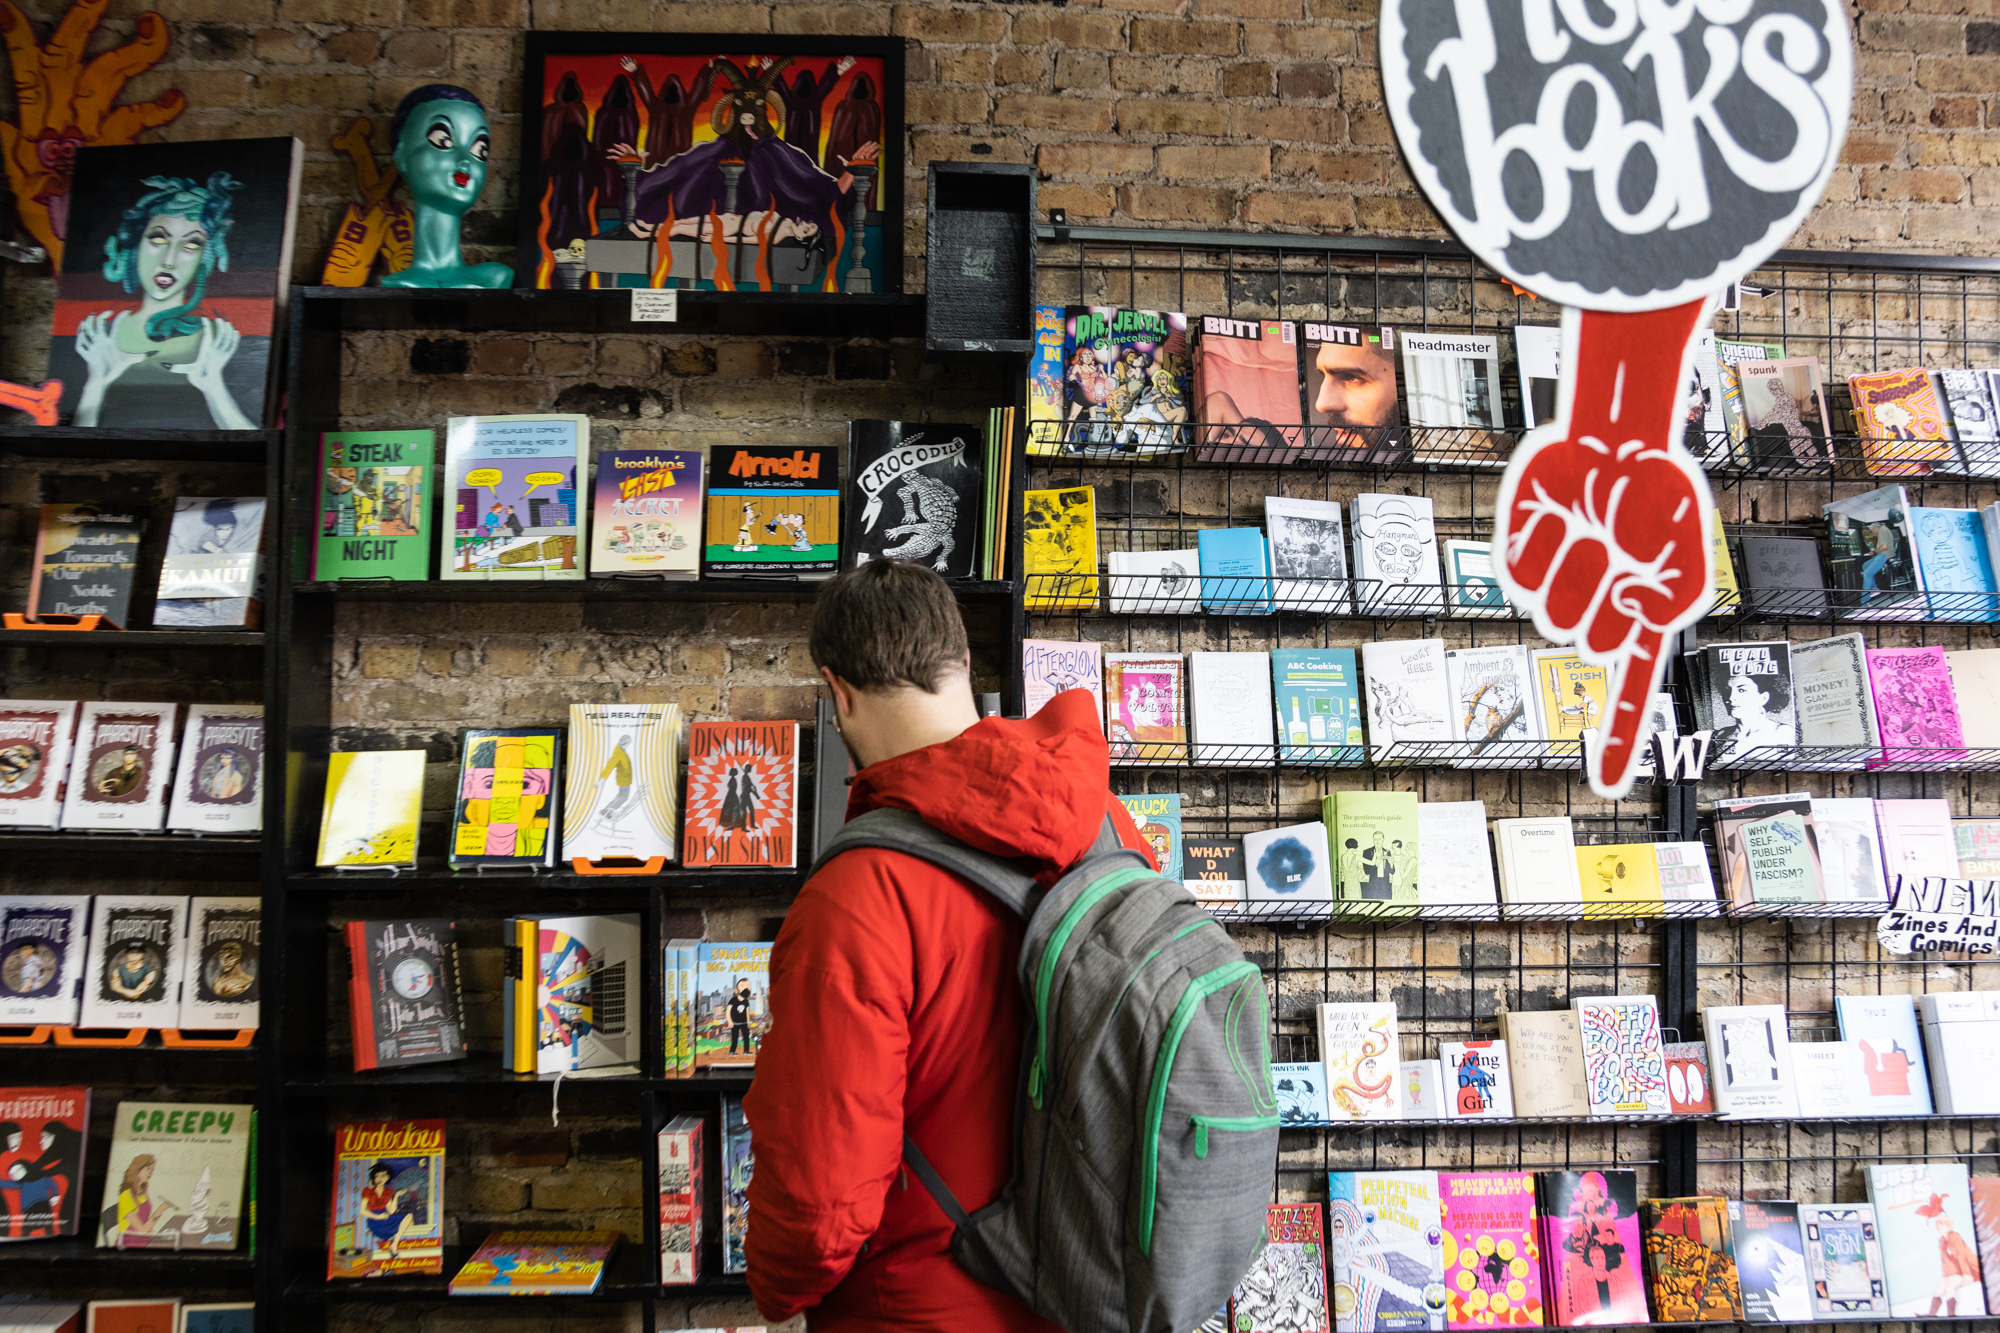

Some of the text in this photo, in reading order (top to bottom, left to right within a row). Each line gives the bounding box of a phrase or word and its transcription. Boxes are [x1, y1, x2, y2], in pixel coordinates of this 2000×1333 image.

[1425, 13, 1832, 249] books
[1043, 308, 1057, 317] My
[1113, 311, 1168, 335] JEKYLL
[1203, 316, 1259, 339] BUTT
[1094, 333, 1162, 350] Gynecologist
[1305, 323, 1360, 345] BUTT
[1044, 346, 1061, 361] IN
[1408, 339, 1491, 353] headmaster
[1721, 342, 1766, 359] CINEMA
[1748, 365, 1778, 376] spunk
[496, 427, 533, 435] HELPLESS
[349, 443, 404, 463] STEAK
[614, 455, 686, 469] brooklyn's
[728, 450, 821, 479] Arnold
[862, 440, 965, 493] CROCODILE
[621, 466, 682, 503] LAST
[611, 498, 684, 517] SECRET
[1377, 528, 1418, 543] Hangman
[62, 550, 130, 563] Towards
[342, 540, 397, 561] NIGHT
[1759, 544, 1779, 557] girl
[52, 567, 85, 580] Our
[162, 566, 250, 585] KAMUI
[1386, 564, 1412, 576] Blood
[70, 584, 117, 597] Noble
[54, 602, 109, 614] Deaths
[1400, 646, 1431, 665] LOOKY
[1720, 648, 1769, 662] HEAD
[1023, 645, 1098, 682] AFTERGLOW
[1287, 661, 1343, 672] ABC Cooking
[1406, 661, 1434, 674] HERE
[1731, 661, 1778, 675] CLOG
[1462, 658, 1500, 687] Ambient
[1474, 671, 1519, 688] Curiosity
[1569, 672, 1602, 681] DISH
[1801, 669, 1847, 684] GORGEOUS
[1803, 679, 1844, 695] MONEY
[1804, 690, 1851, 704] GLAMOROUS
[1129, 703, 1185, 712] VOLUME
[1806, 698, 1852, 713] PEOPLE
[611, 712, 662, 720] REALITIES
[694, 725, 791, 757] DISCIPLINE
[1134, 798, 1170, 816] LUCK
[1741, 797, 1767, 805] PUBLISHING
[1353, 814, 1386, 822] gentleman's
[1386, 814, 1402, 822] guide
[1350, 822, 1376, 830] catcalling
[1520, 828, 1556, 837] Overtime
[1747, 825, 1769, 836] WHY
[1749, 836, 1778, 847] SELF-
[687, 835, 786, 864] DASH SHAW
[1189, 847, 1236, 858] WHAT'
[1752, 845, 1792, 858] PUBLISH
[1206, 859, 1217, 870] D
[1753, 858, 1786, 869] UNDER
[1199, 871, 1229, 882] YOU
[1286, 874, 1302, 883] BLUE
[1674, 866, 1704, 883] CLAI
[1755, 868, 1804, 881] FASCISM?
[1890, 874, 2000, 917] NEW
[1889, 912, 1997, 937] Zines And
[1910, 933, 1993, 954] Comics
[711, 947, 749, 961] SNAKE
[706, 961, 725, 972] BIG
[1584, 1004, 1655, 1032] BOFFO
[1863, 1008, 1888, 1018] TFU 2
[1335, 1021, 1360, 1032] BEEN
[1519, 1027, 1570, 1042] WHY ARE YOU
[1586, 1028, 1659, 1056] BOFFO
[1333, 1039, 1360, 1049] GOING
[1516, 1040, 1575, 1054] LOOKING AT ME
[1331, 1050, 1353, 1071] #1
[1450, 1053, 1499, 1069] Living
[1522, 1051, 1568, 1066] LIKE THAT?
[1807, 1052, 1836, 1060] TOILET
[1589, 1051, 1661, 1080] BOFFO
[1457, 1072, 1497, 1088] Dead
[1463, 1093, 1494, 1109] Girl
[131, 1109, 235, 1136] CREEPY
[343, 1121, 443, 1152] Undertow
[1450, 1177, 1522, 1188] HEAVEN IS AN
[1872, 1164, 1929, 1191] JUST
[1361, 1179, 1431, 1201] PERPETUAL
[1451, 1185, 1522, 1197] AFTER PARTY
[1893, 1176, 1934, 1206] US
[1362, 1191, 1408, 1210] MOTION
[1378, 1206, 1420, 1232] MACHINE
[1452, 1211, 1523, 1221] HEAVEN IS AN
[1454, 1220, 1524, 1230] AFTER PARTY
